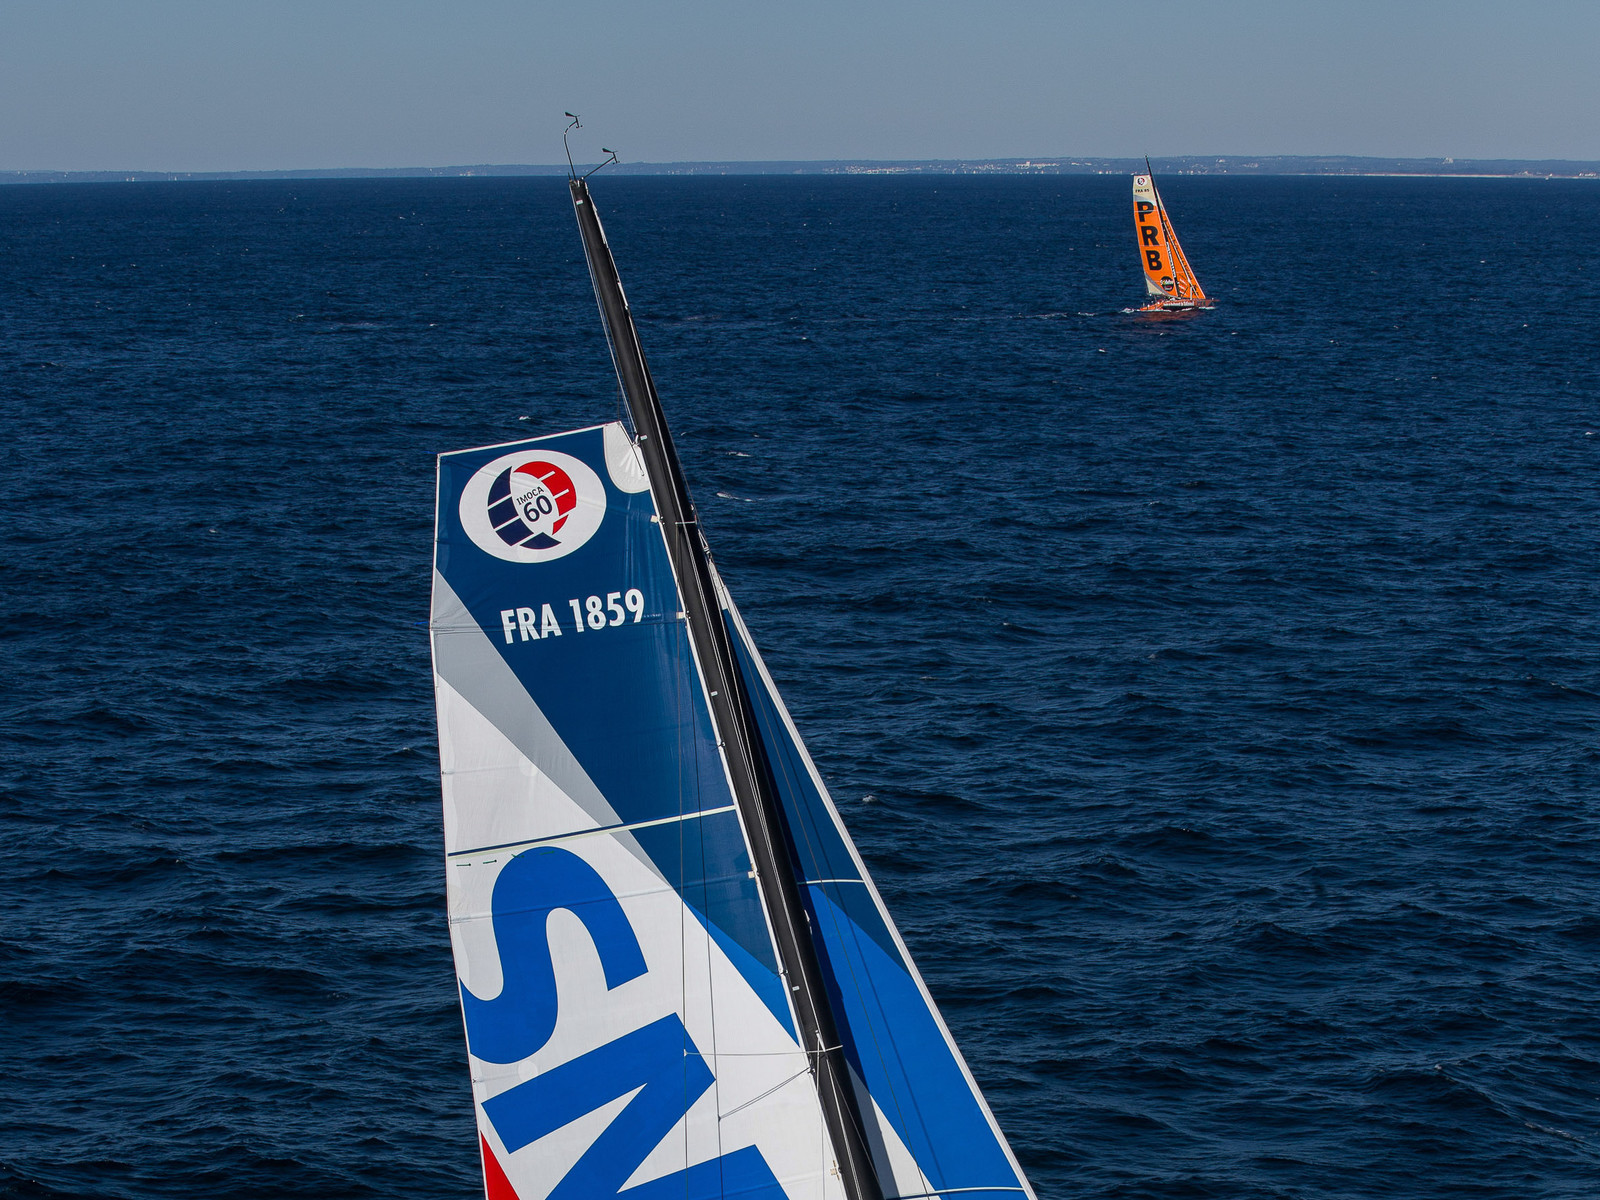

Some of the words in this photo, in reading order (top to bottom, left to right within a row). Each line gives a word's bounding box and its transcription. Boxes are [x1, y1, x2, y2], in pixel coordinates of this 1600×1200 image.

[1136, 201, 1163, 271] PRB
[516, 486, 544, 505] IMOCA
[523, 495, 552, 522] 60
[500, 603, 562, 644] FRA
[568, 588, 645, 633] 1859
